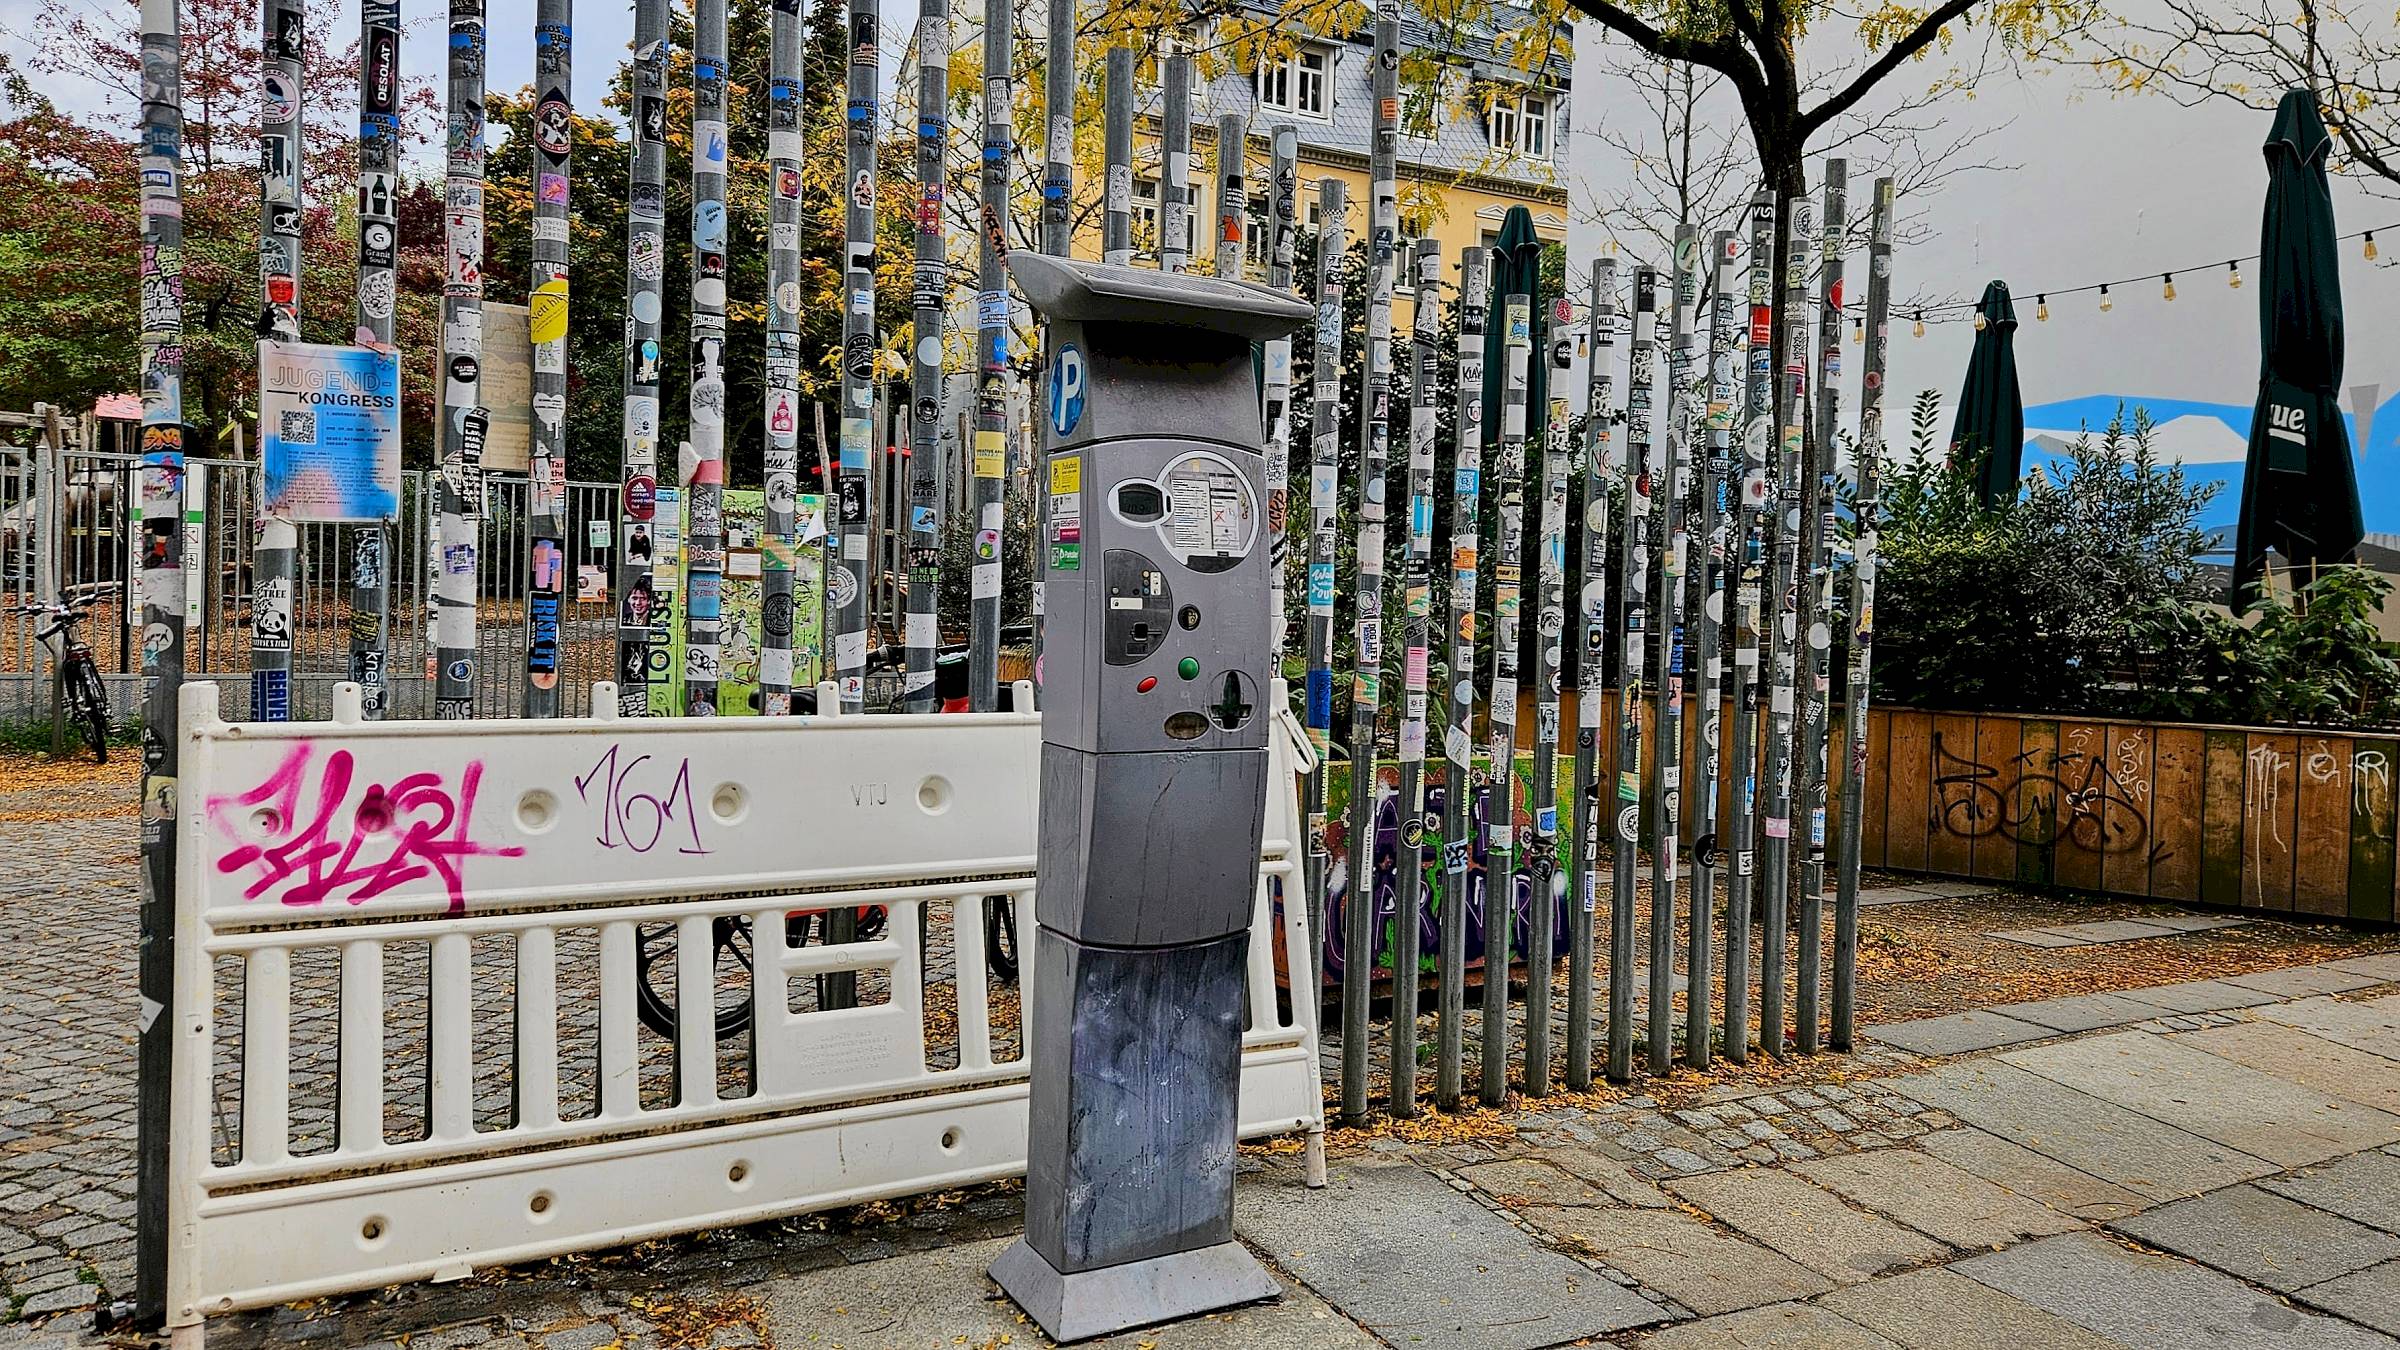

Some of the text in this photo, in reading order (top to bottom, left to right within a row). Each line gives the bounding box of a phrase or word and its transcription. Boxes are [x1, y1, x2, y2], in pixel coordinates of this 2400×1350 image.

[377, 45, 391, 101] DESOLAT
[365, 249, 391, 259] Granit
[270, 366, 393, 392] JUGEND-
[298, 391, 395, 408] KONGRESS
[1061, 346, 1084, 431] P
[263, 589, 287, 599] TREE
[530, 598, 558, 668] RISK IT
[365, 651, 382, 711] kneipe
[574, 743, 714, 855] 161
